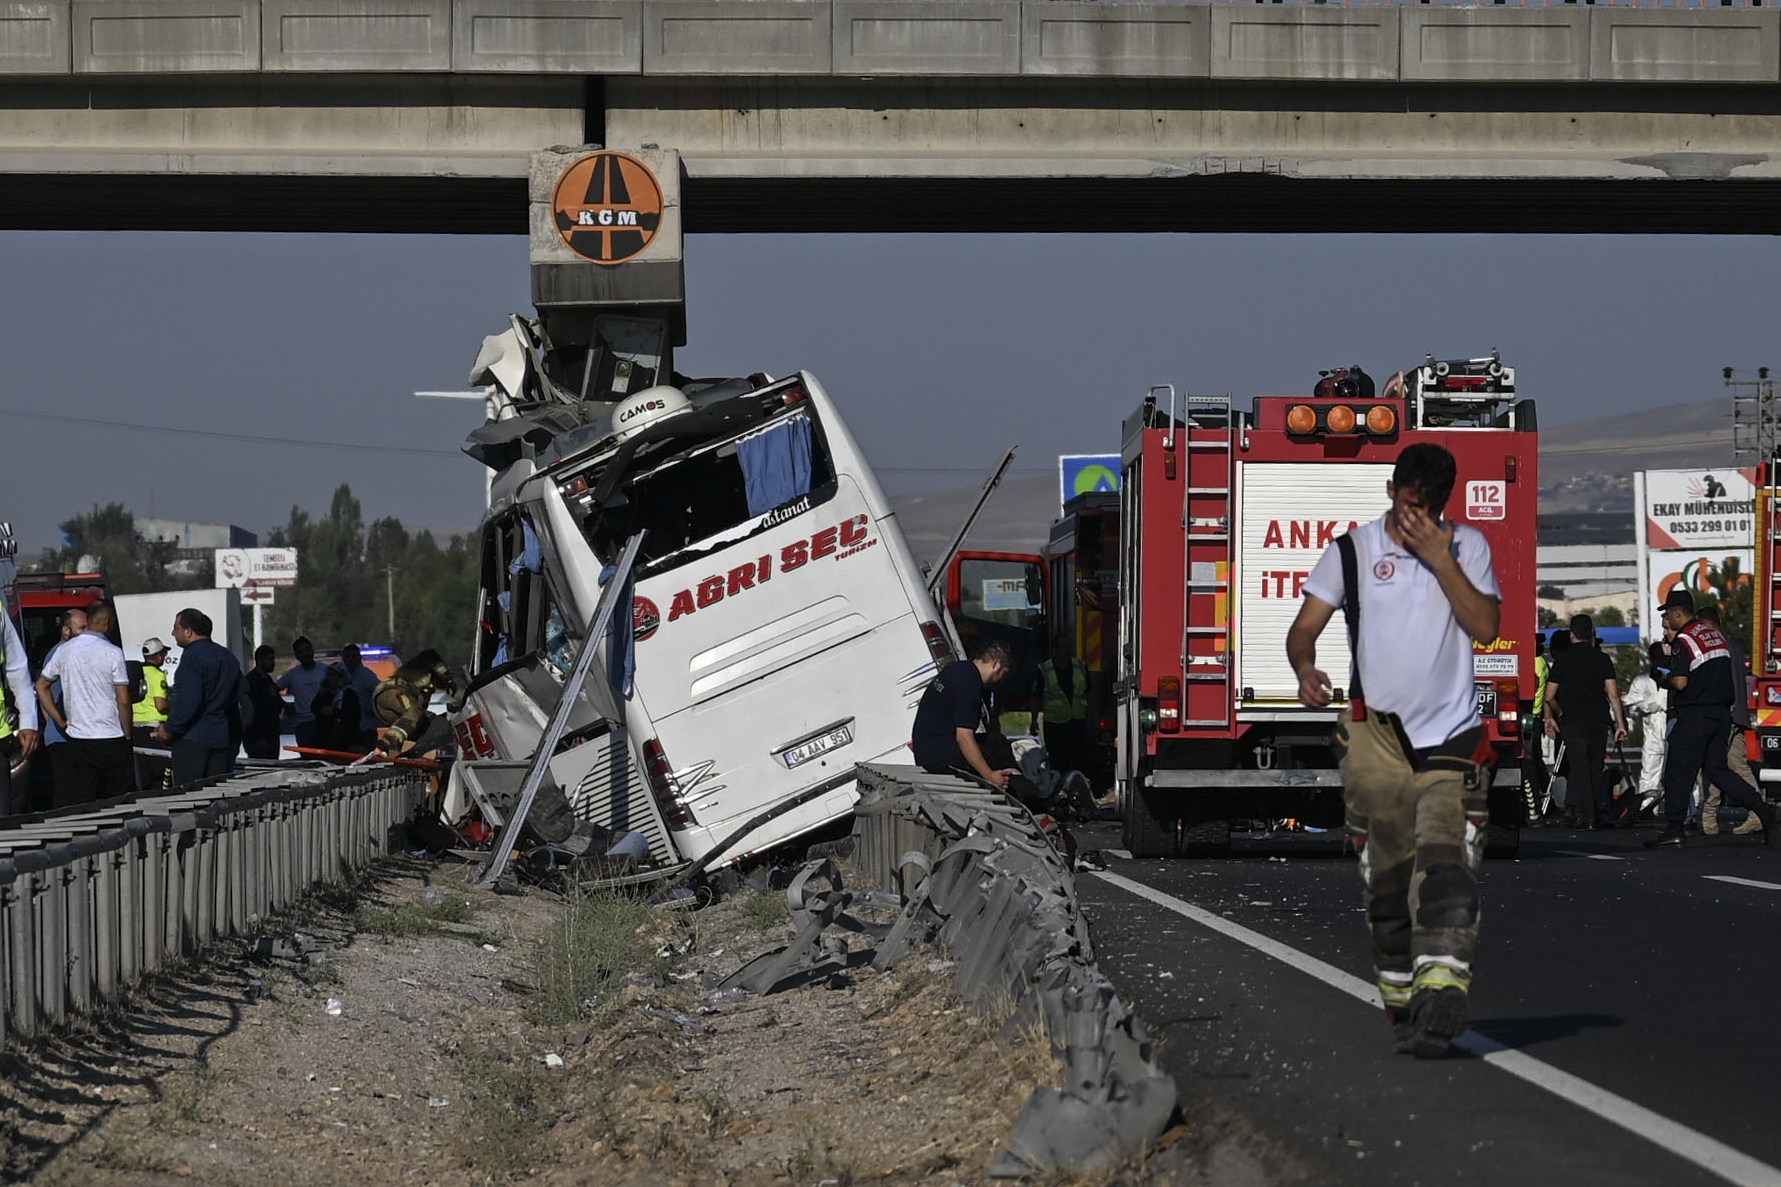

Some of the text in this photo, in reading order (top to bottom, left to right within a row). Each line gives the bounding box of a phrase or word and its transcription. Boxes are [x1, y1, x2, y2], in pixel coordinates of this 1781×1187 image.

[578, 209, 637, 225] KGM
[619, 399, 666, 423] CAMOS
[1472, 485, 1500, 503] 112
[1653, 503, 1681, 517] EKAY
[1669, 520, 1752, 533] 0533 299 01 01
[792, 729, 850, 762] 04 AAV 951
[1766, 737, 1779, 748] 06
